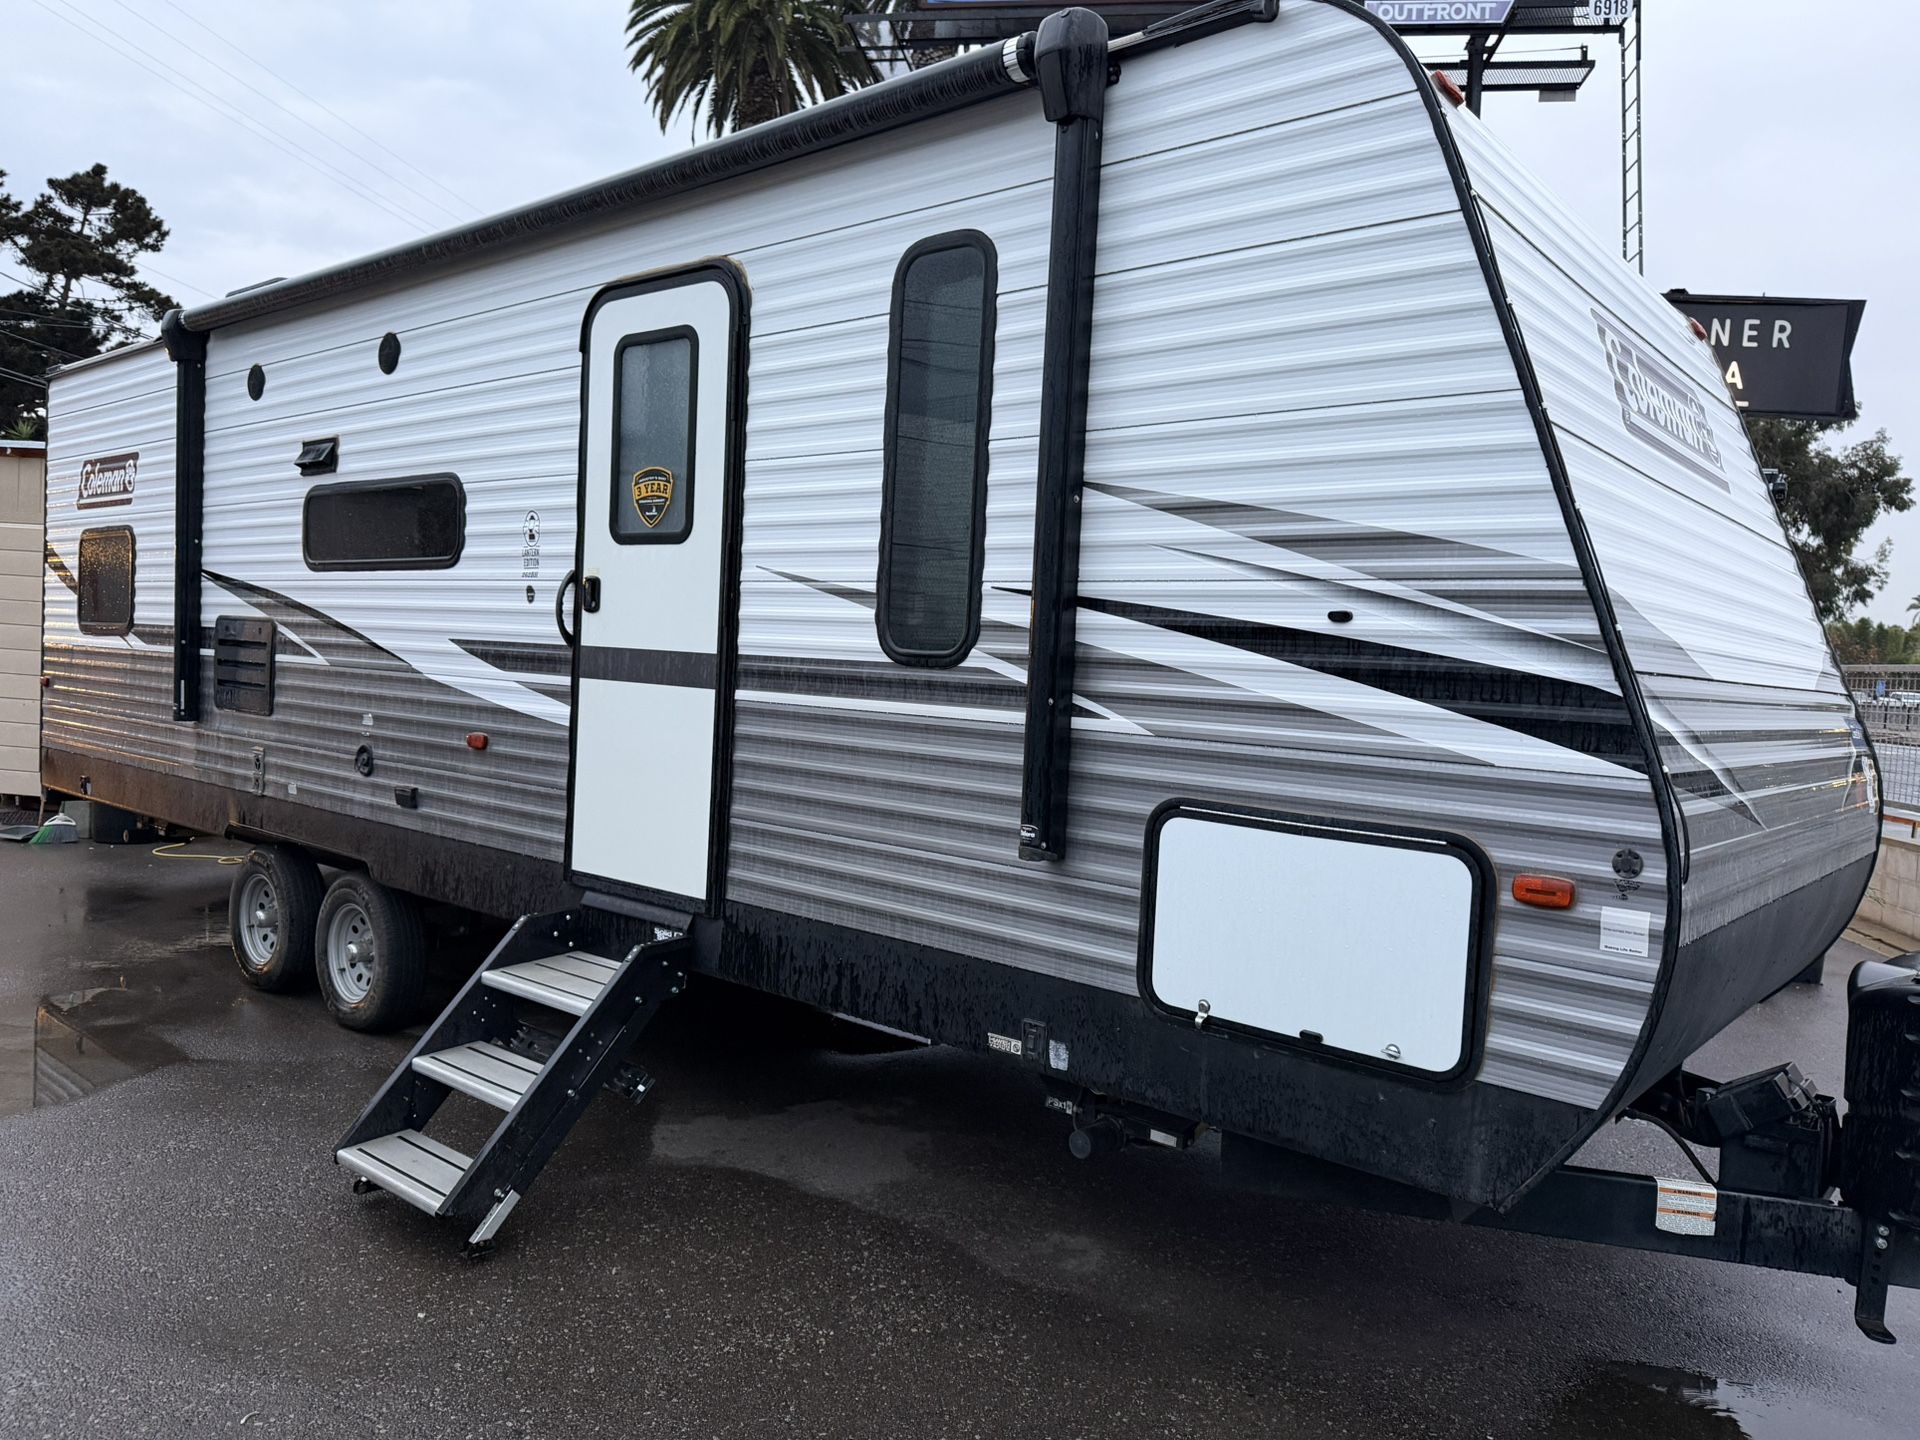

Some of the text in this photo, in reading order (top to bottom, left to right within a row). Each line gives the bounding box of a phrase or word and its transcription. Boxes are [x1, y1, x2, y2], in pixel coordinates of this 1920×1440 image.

[1377, 2, 1496, 21] OUTFRONT
[1593, 0, 1629, 16] 6918
[80, 462, 125, 498] Coleman
[636, 482, 669, 497] 3 YEAR
[521, 548, 540, 557] LANTERN
[523, 558, 540, 567] EDITION
[1677, 1189, 1702, 1197] WARNING
[1676, 1209, 1701, 1217] WARNING
